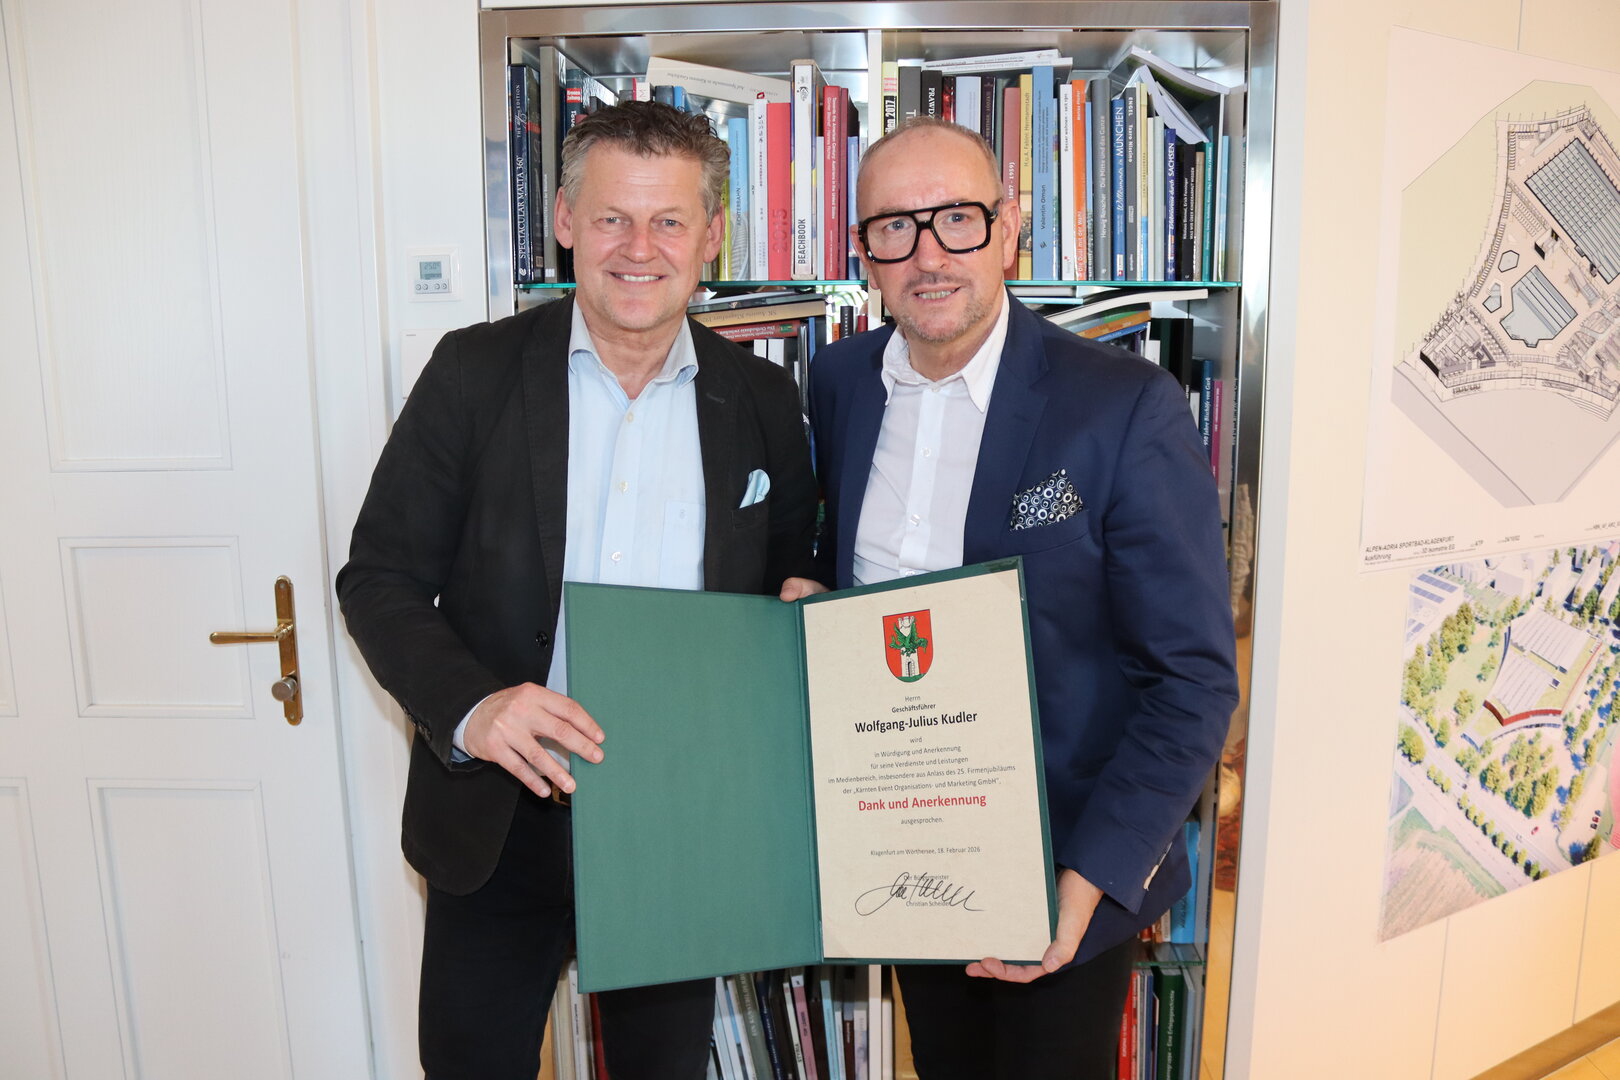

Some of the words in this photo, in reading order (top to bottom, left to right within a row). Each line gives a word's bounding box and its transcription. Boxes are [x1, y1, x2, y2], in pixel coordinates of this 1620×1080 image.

[1114, 106, 1124, 157] MÜNCHEN
[1167, 142, 1175, 177] SACHSEN
[517, 170, 526, 200] MALTA
[517, 200, 527, 259] SPECTACULAR
[772, 209, 788, 253] 2015
[797, 218, 806, 264] BEACHBOOK
[891, 703, 937, 714] Geschäftsführer
[855, 715, 939, 733] Wolfgang-Julius
[941, 711, 978, 725] Kudler
[909, 736, 923, 744] wird
[880, 748, 911, 759] Würdigung
[923, 745, 962, 754] Anerkennung
[895, 759, 925, 768] Verdienste
[926, 758, 937, 766] und
[937, 756, 969, 766] Leistungen
[878, 772, 915, 781] insbesondere
[926, 769, 945, 777] Anlass
[945, 768, 956, 776] des
[967, 765, 1016, 775] Firmenjubiläums
[894, 782, 934, 792] Organisations-
[935, 781, 947, 789] und
[947, 779, 977, 790] Marketing
[858, 798, 886, 812] Dank
[888, 797, 909, 810] und
[911, 795, 987, 810] Anerkennung
[900, 816, 945, 826] ausgesprochen.
[870, 849, 895, 858] Klagenfurt
[905, 848, 937, 858] Wörthersee,
[946, 847, 967, 855] Februar
[913, 873, 950, 882] Bürgermeister
[905, 900, 929, 908] Christian
